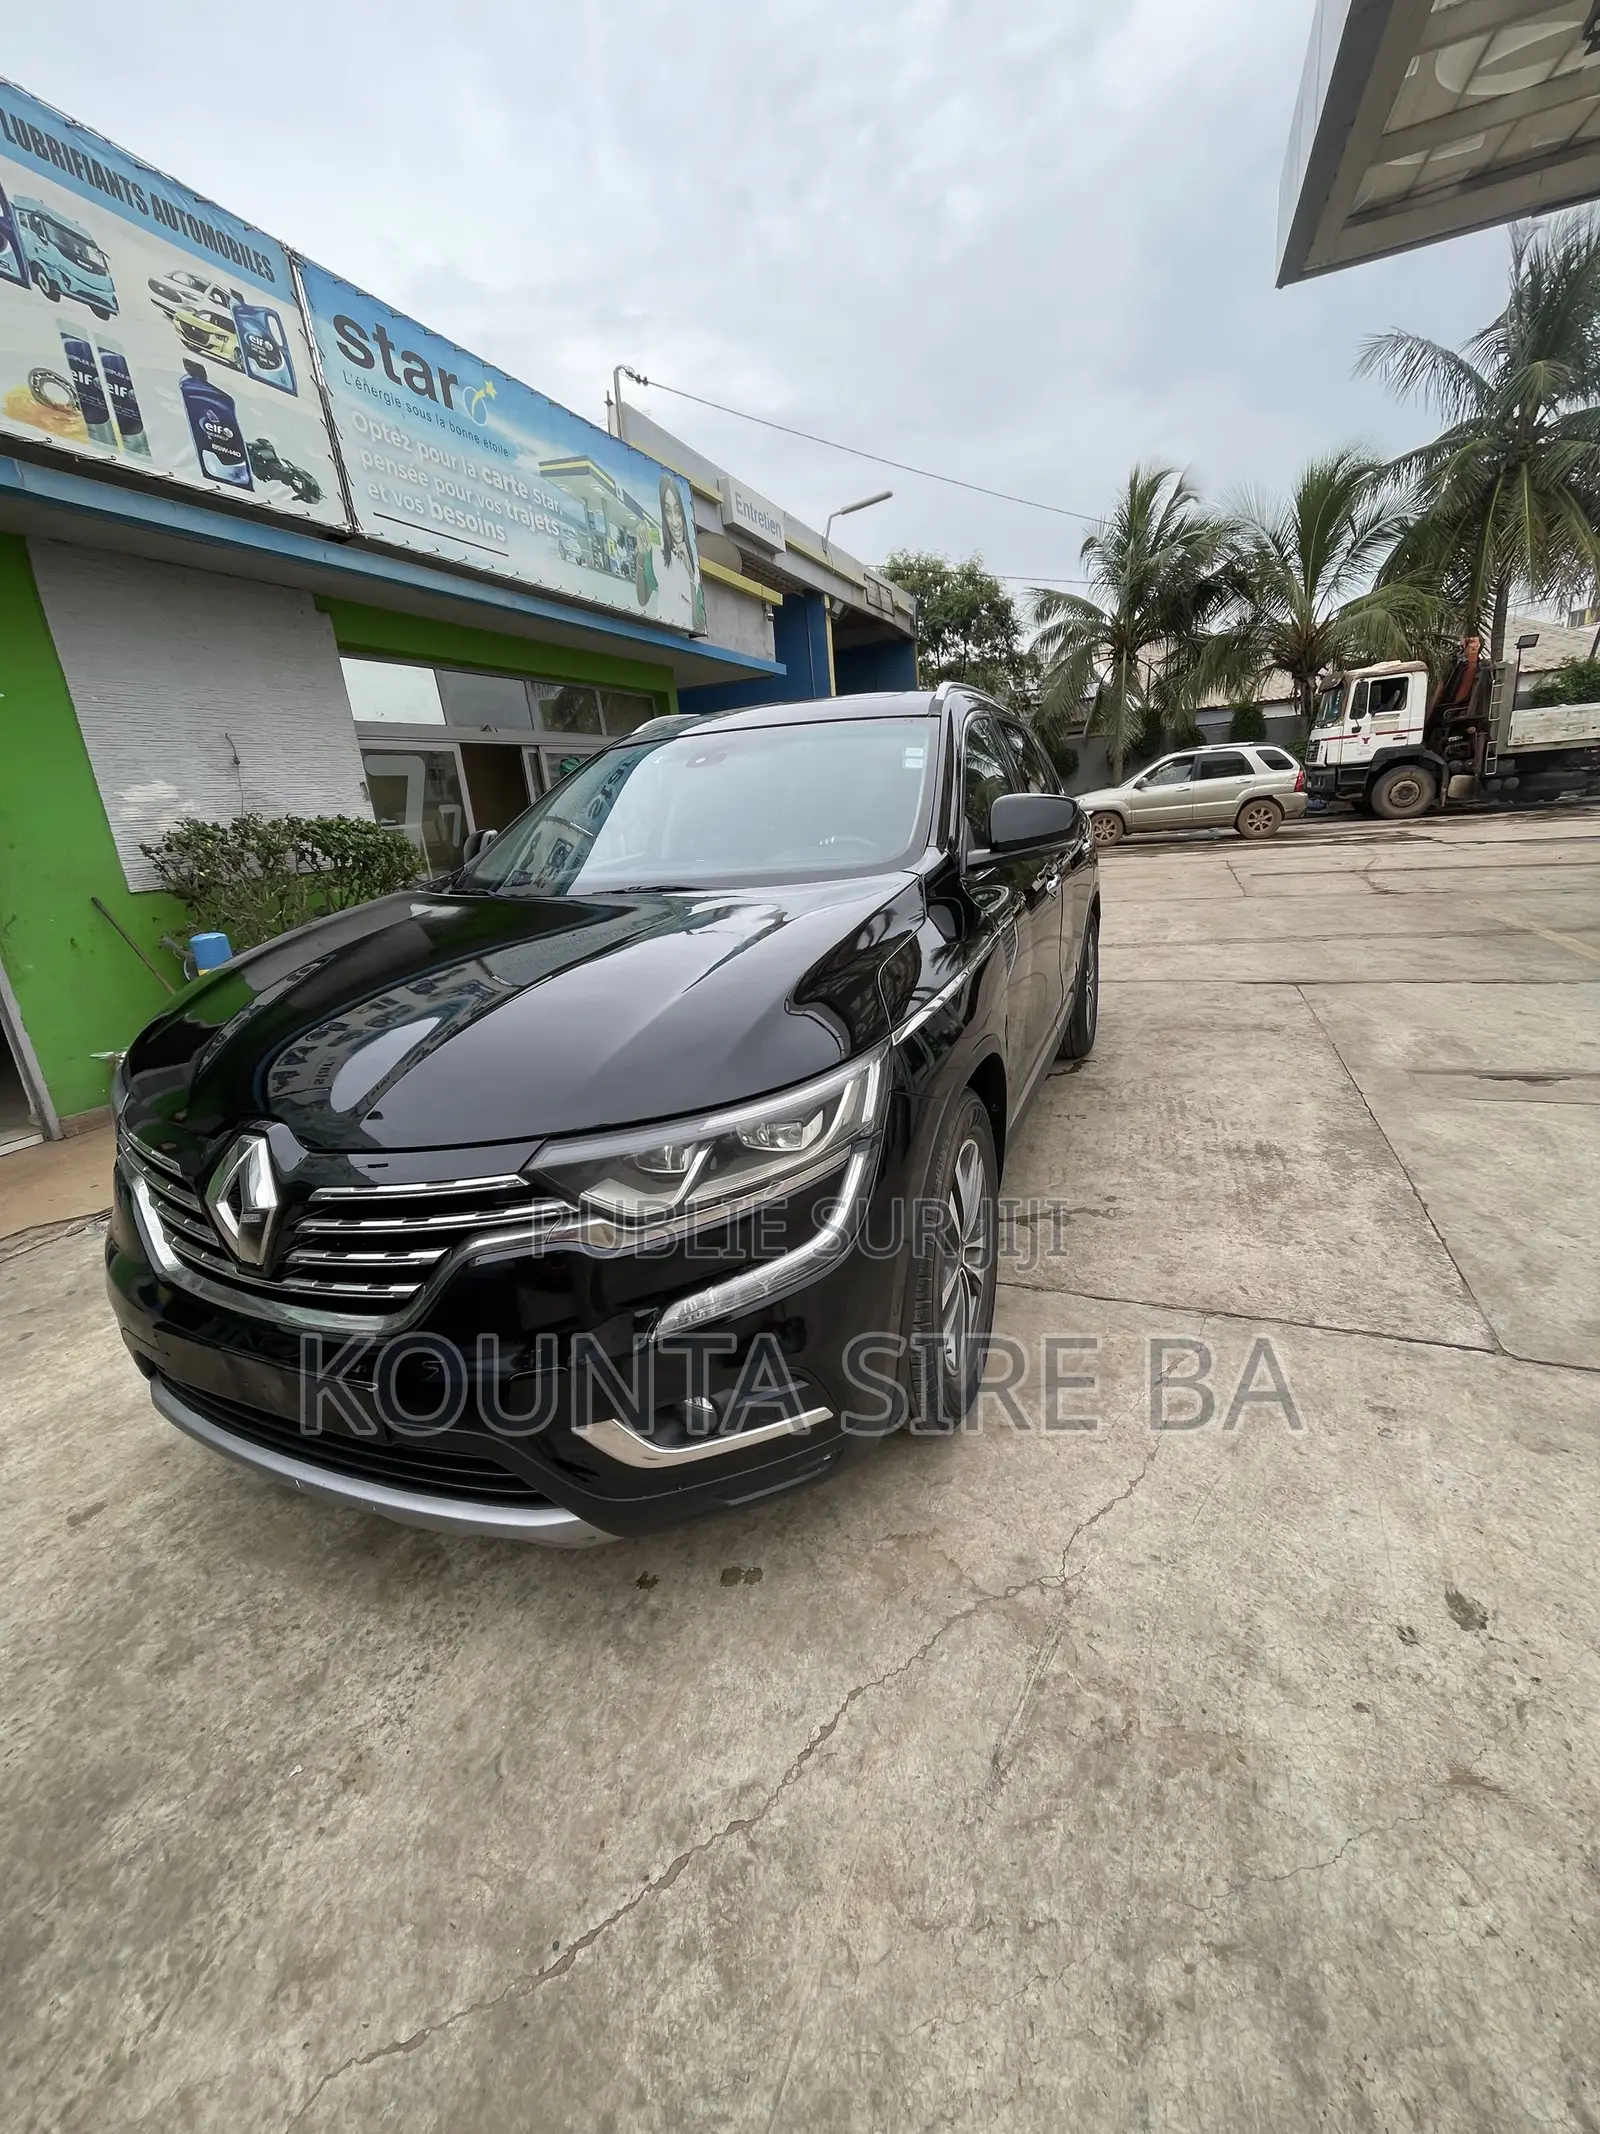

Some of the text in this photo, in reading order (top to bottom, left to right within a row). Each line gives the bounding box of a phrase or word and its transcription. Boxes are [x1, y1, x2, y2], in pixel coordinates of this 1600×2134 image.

[0, 107, 275, 283] LUBRIFIANTS AUTOMOBILES
[333, 314, 459, 411] star
[342, 369, 509, 458] L'énergie sous la bonne étoile
[351, 410, 413, 452] Optez
[417, 440, 459, 469] pour
[461, 455, 477, 479] la
[481, 466, 528, 499] carte
[361, 449, 560, 536] pensée pour vos trajets
[367, 482, 507, 543] et vos besoins
[734, 491, 782, 539] Entretien
